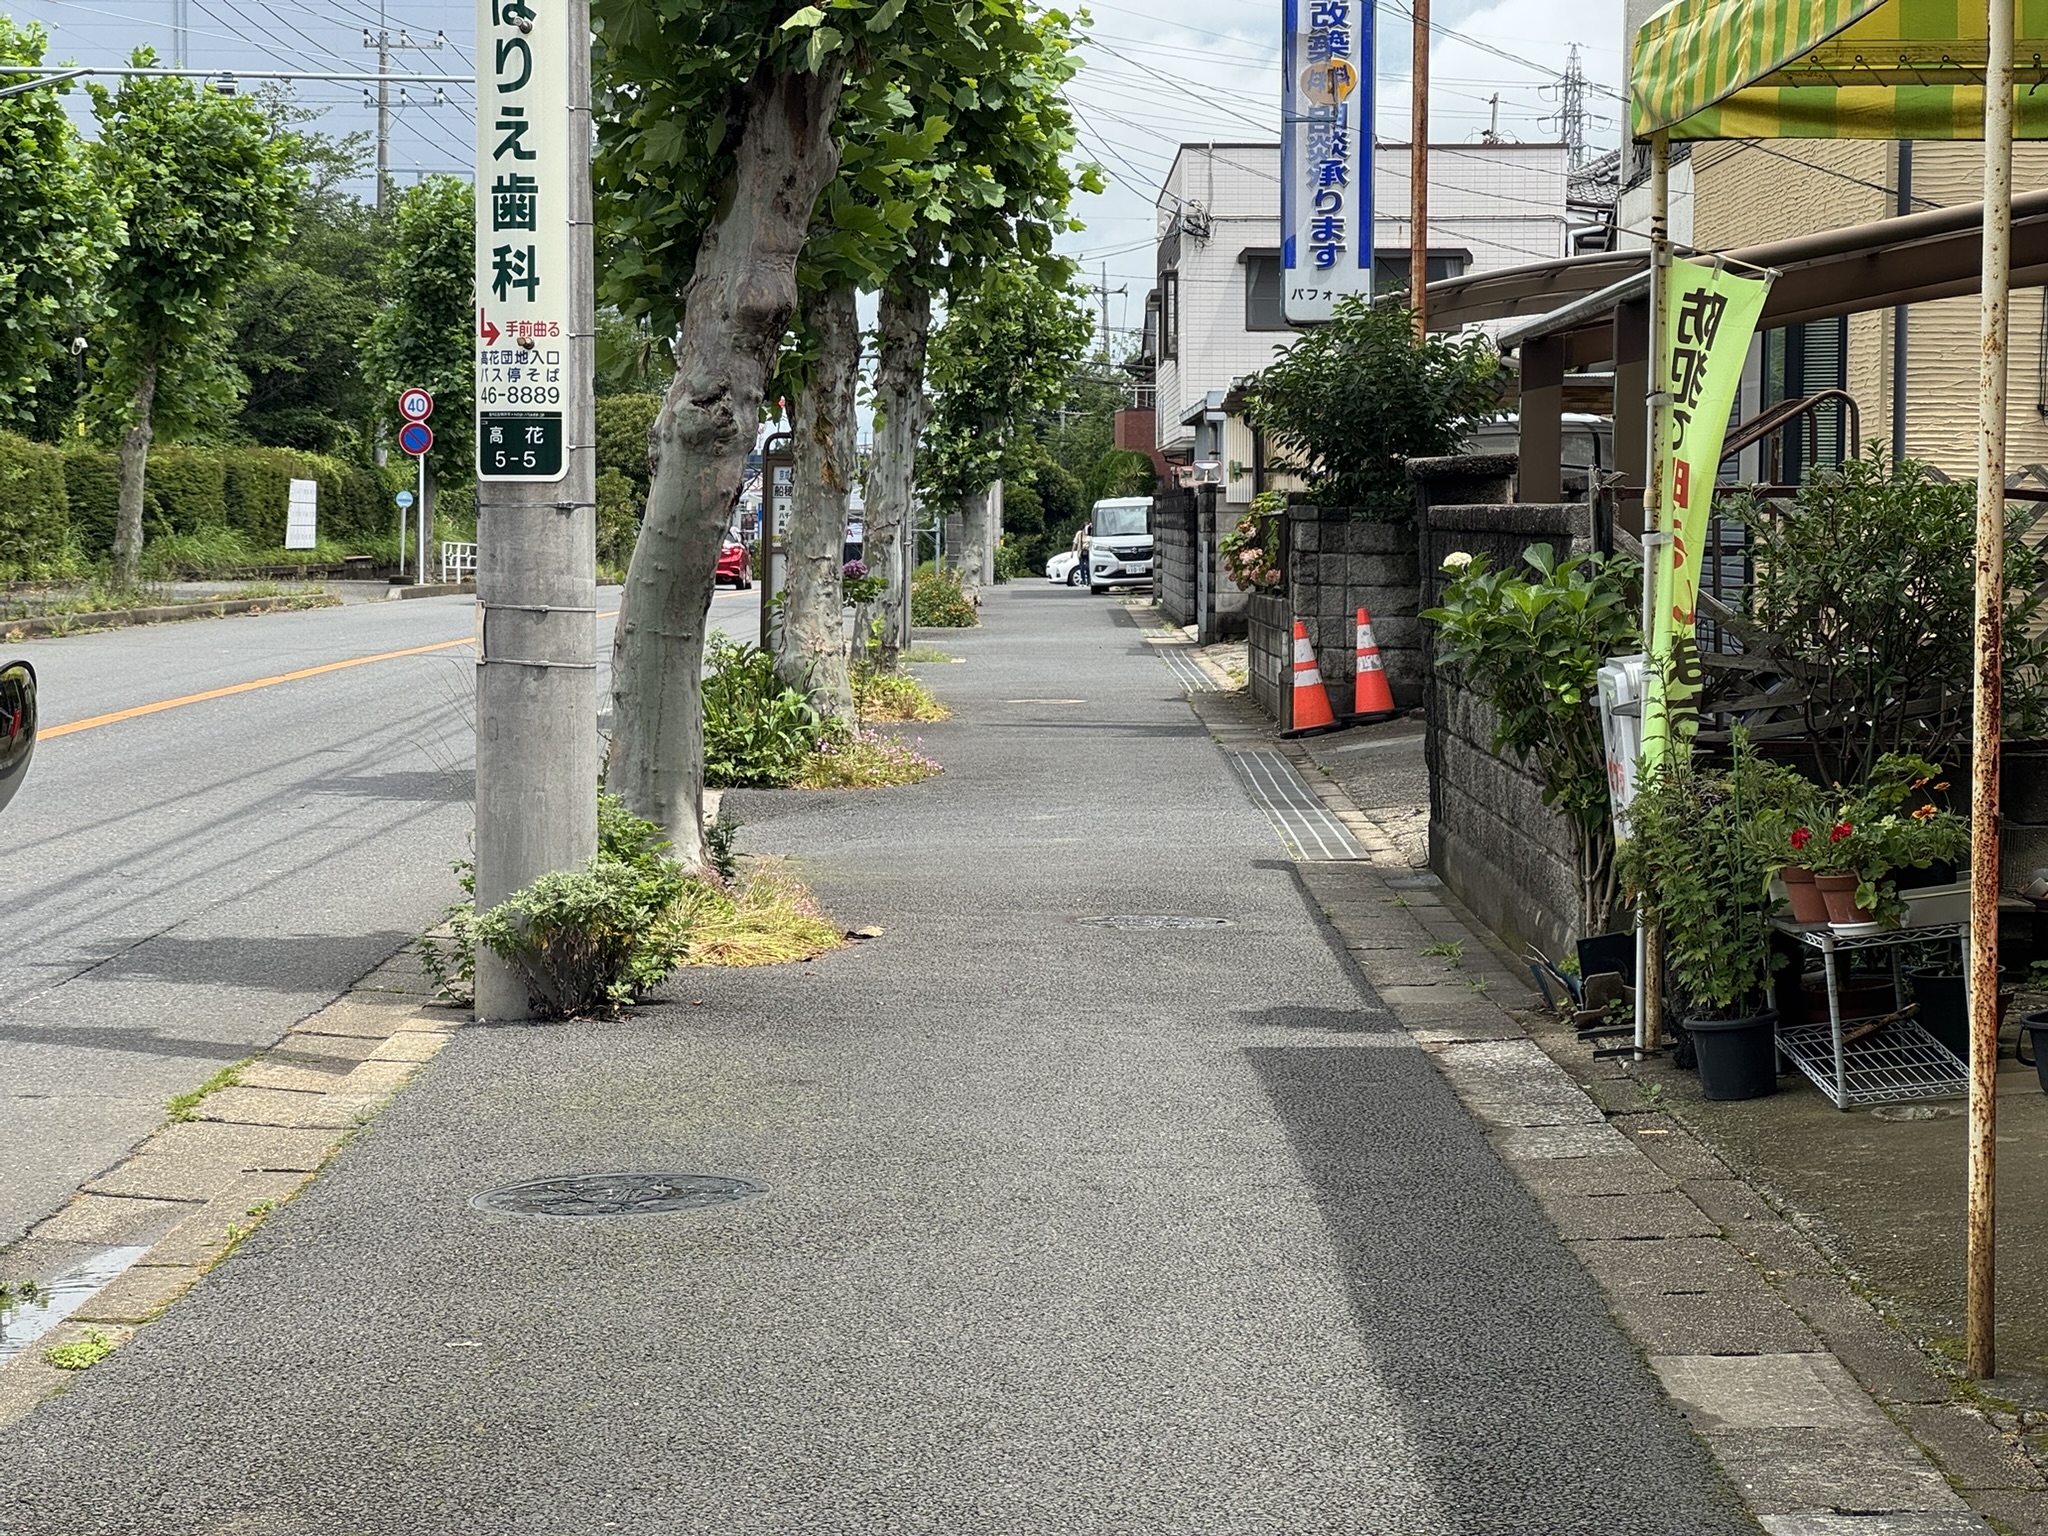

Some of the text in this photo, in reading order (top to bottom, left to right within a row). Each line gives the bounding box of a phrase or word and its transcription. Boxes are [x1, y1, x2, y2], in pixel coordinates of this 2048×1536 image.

[505, 320, 561, 338] 手前曲る
[481, 350, 560, 365] 高花団地入口
[481, 367, 560, 383] バス停そば
[481, 385, 560, 405] 46-8889
[407, 398, 425, 413] 40
[494, 450, 537, 468] 5-5
